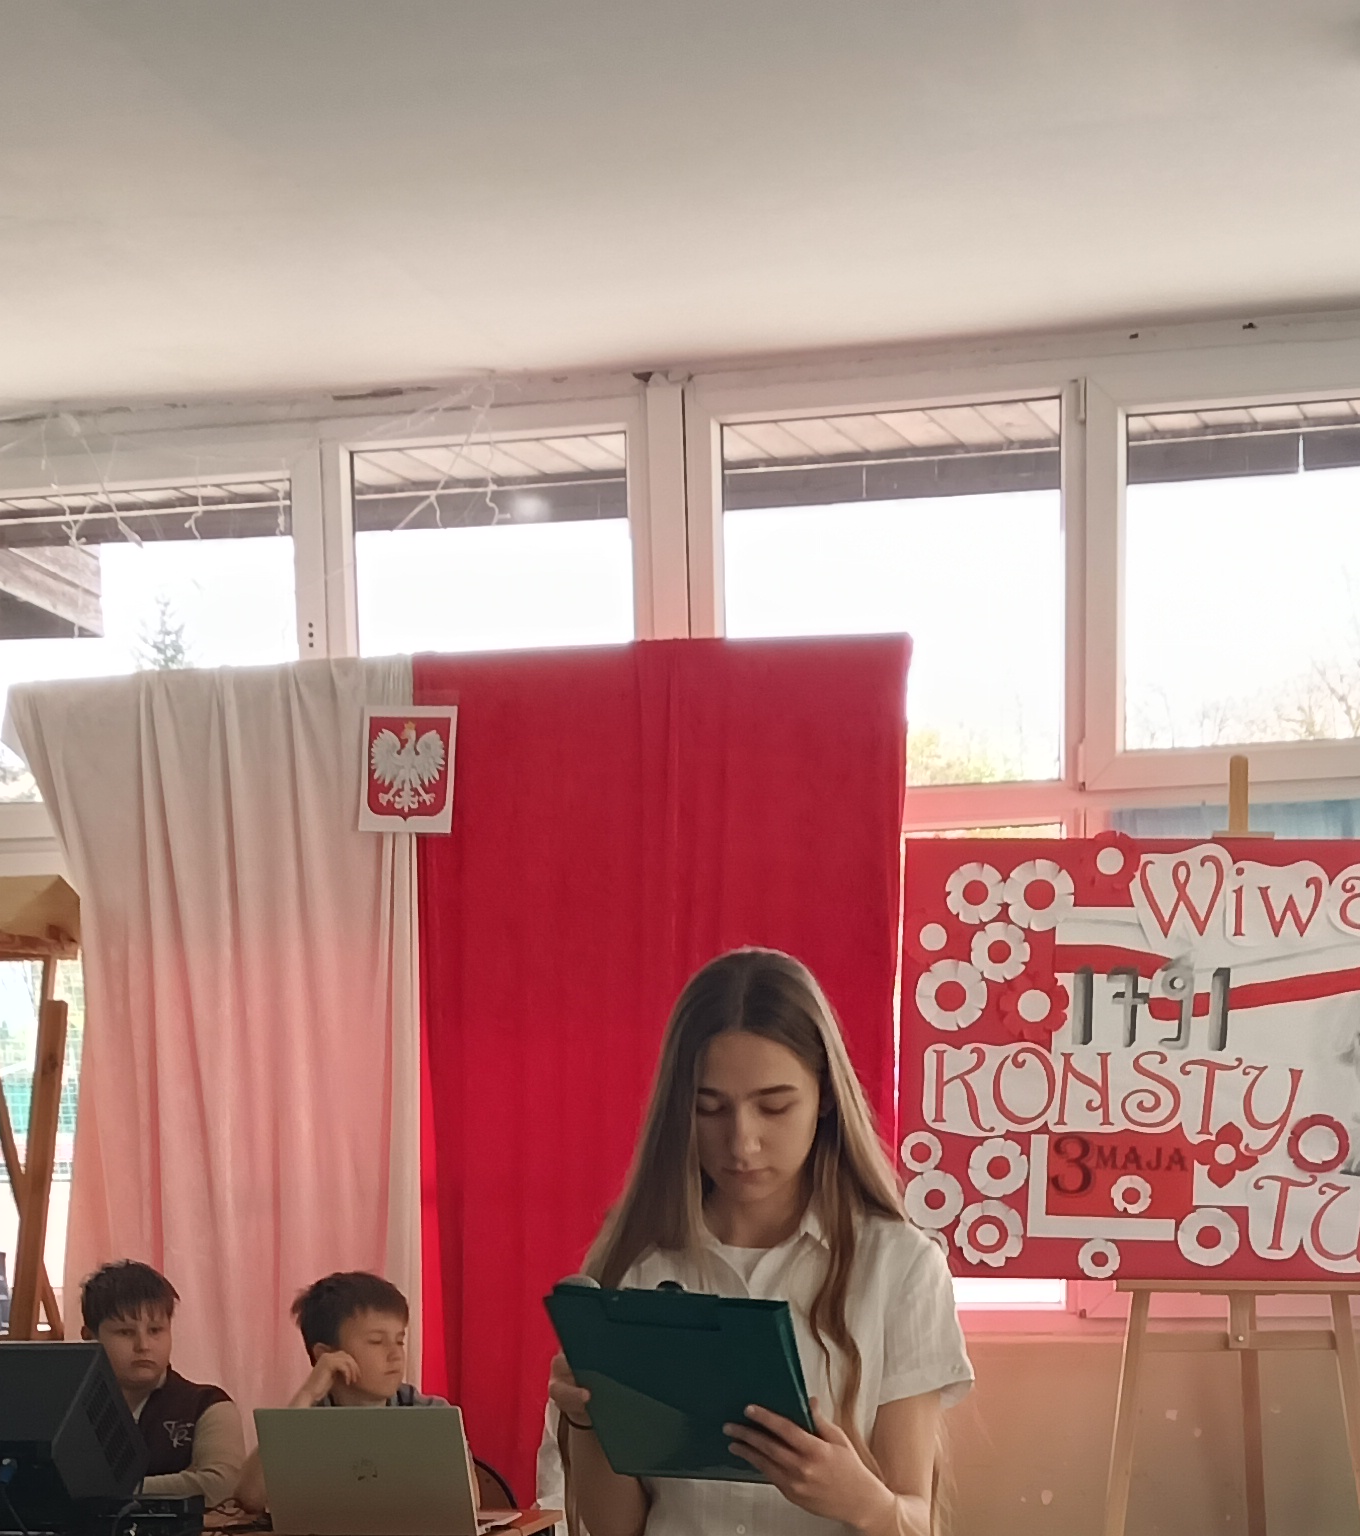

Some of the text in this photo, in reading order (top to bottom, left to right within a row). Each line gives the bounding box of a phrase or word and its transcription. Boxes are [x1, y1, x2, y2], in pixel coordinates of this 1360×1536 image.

[1072, 953, 1232, 1051] 1791
[931, 1044, 1303, 1155] KONSTY
[1050, 1135, 1191, 1196] 3 MAJA
